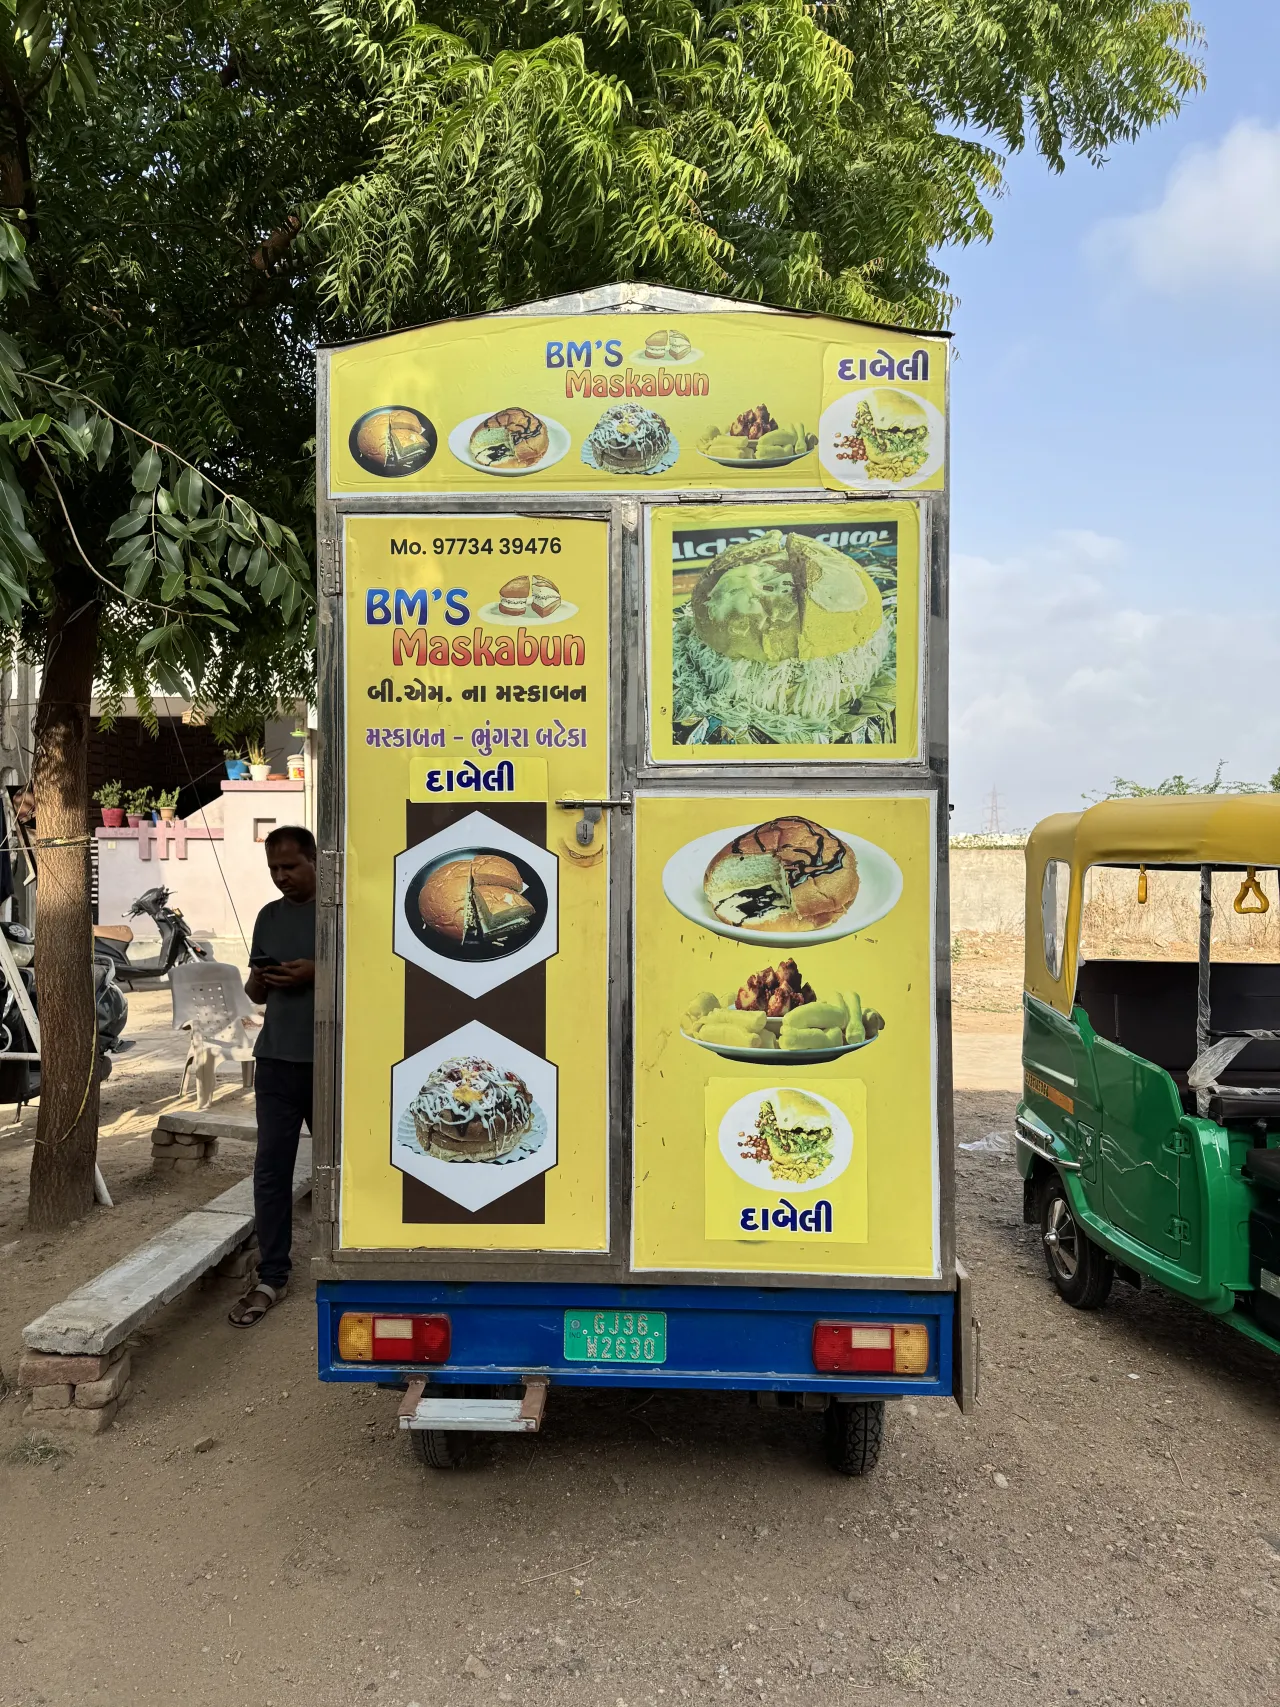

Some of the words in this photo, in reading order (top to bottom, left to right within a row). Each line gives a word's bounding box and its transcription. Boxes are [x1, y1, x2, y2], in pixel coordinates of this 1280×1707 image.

[837, 348, 929, 381] દાબેલી
[565, 367, 710, 398] Maskabun
[390, 538, 427, 555] Mo.
[432, 537, 493, 555] 97734
[499, 537, 562, 555] 39476
[392, 626, 586, 667] Maskabun
[461, 685, 487, 703] ના
[496, 685, 587, 703] મસ્કાબન
[365, 728, 446, 748] મસ્કાબન
[535, 719, 587, 748] બટેકા
[425, 759, 515, 792] દાબેલી
[739, 1198, 833, 1233] દાબેલી
[593, 1312, 649, 1336] GJ36
